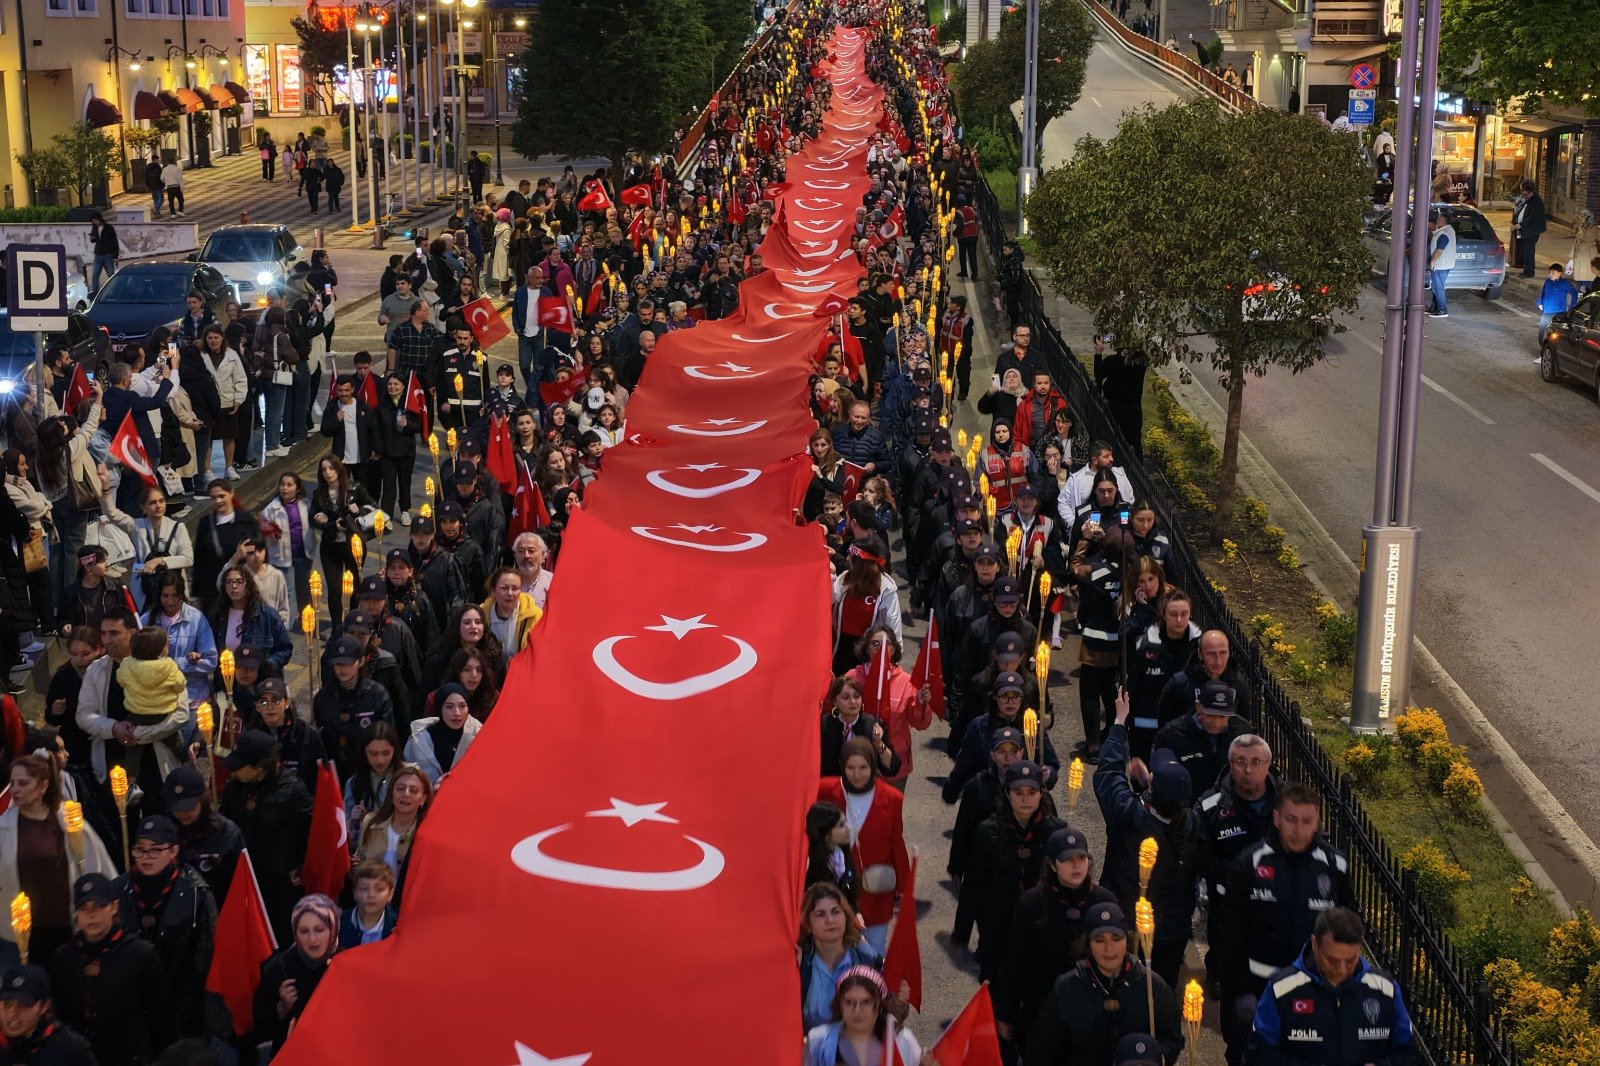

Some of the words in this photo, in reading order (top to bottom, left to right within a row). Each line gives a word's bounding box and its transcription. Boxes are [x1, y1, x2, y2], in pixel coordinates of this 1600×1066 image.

[22, 260, 55, 301] D
[1386, 543, 1400, 605] BELEDİYESİ
[1380, 607, 1396, 673] BÜYÜKŞEHİR
[1379, 675, 1391, 719] SAMSUN
[1291, 1028, 1318, 1038] POLİS
